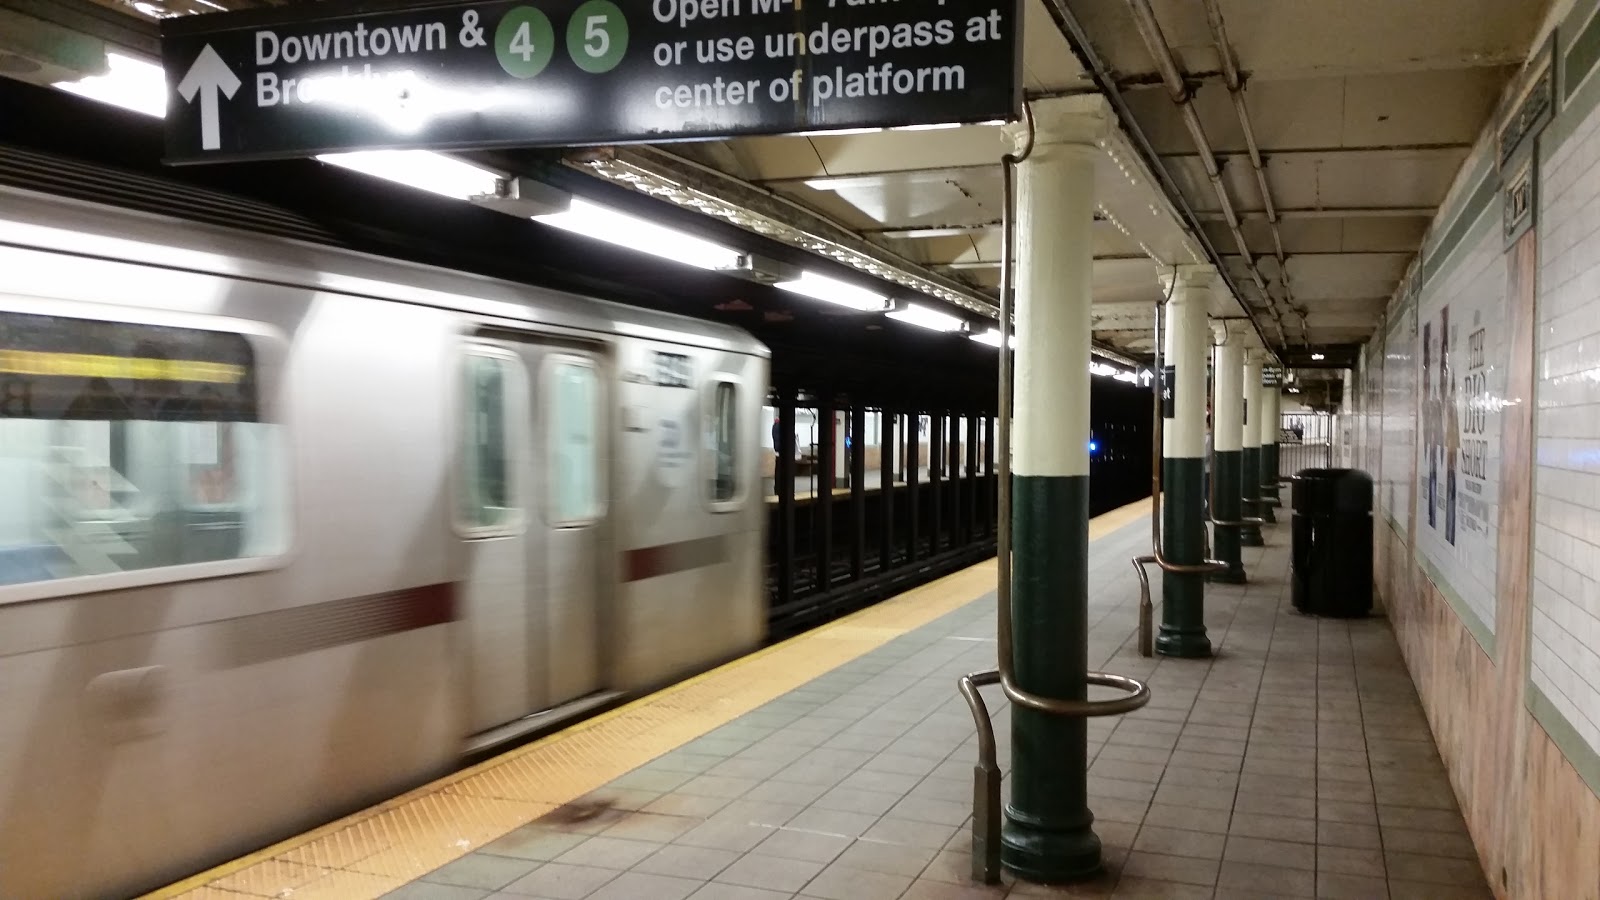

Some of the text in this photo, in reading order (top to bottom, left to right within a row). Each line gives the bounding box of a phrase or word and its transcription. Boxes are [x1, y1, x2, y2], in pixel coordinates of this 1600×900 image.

[652, 0, 740, 28] Open
[255, 9, 610, 66] Downtown & 4 5
[653, 9, 1002, 67] or use underpass at
[654, 63, 966, 109] center of platform
[1468, 328, 1486, 370] THE
[1460, 439, 1488, 481] SHORT
